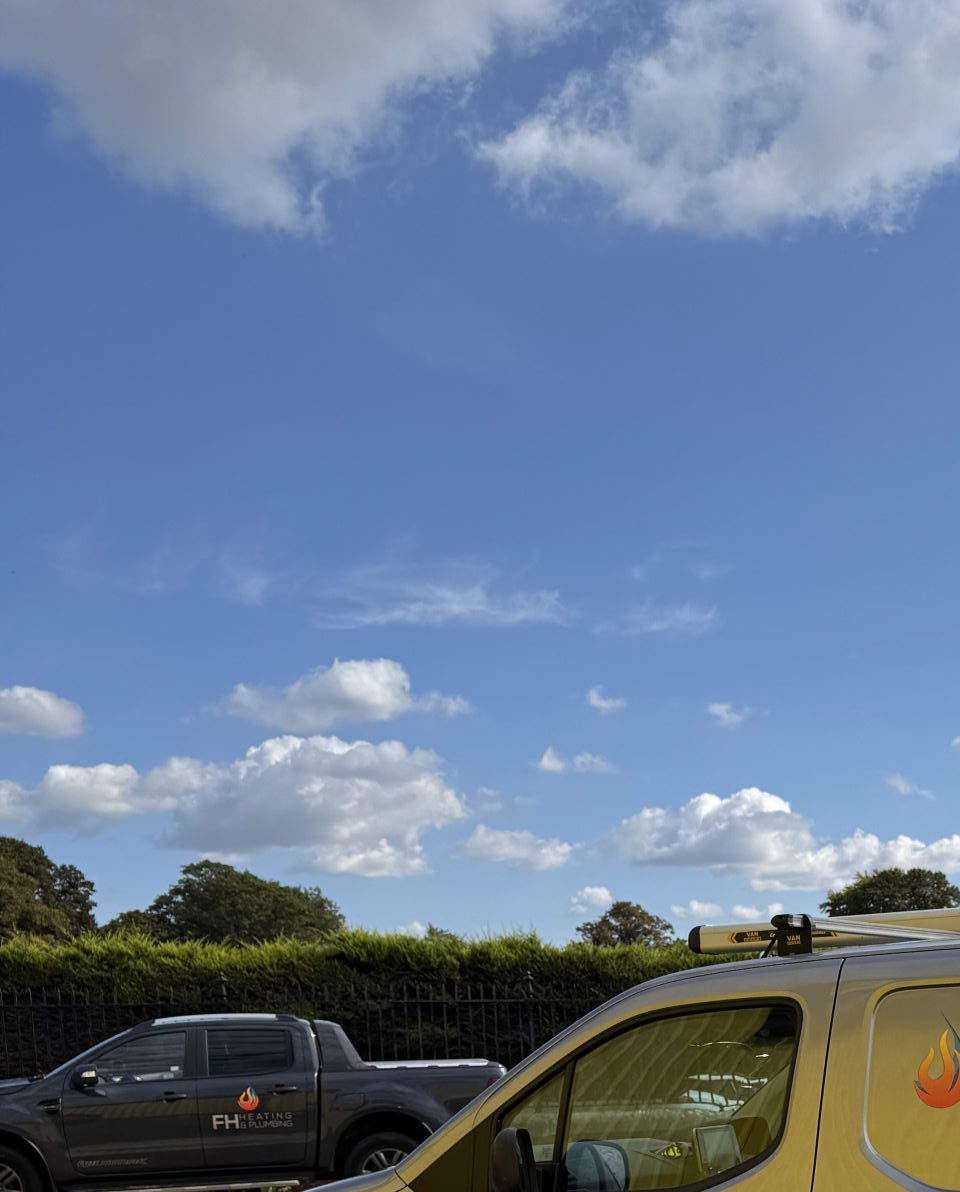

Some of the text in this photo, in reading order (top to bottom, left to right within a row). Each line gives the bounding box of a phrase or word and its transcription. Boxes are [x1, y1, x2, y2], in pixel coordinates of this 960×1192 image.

[787, 934, 801, 942] VAN
[239, 1111, 293, 1121] HEATING
[212, 1113, 240, 1130] FH
[248, 1120, 293, 1129] PLUMBING
